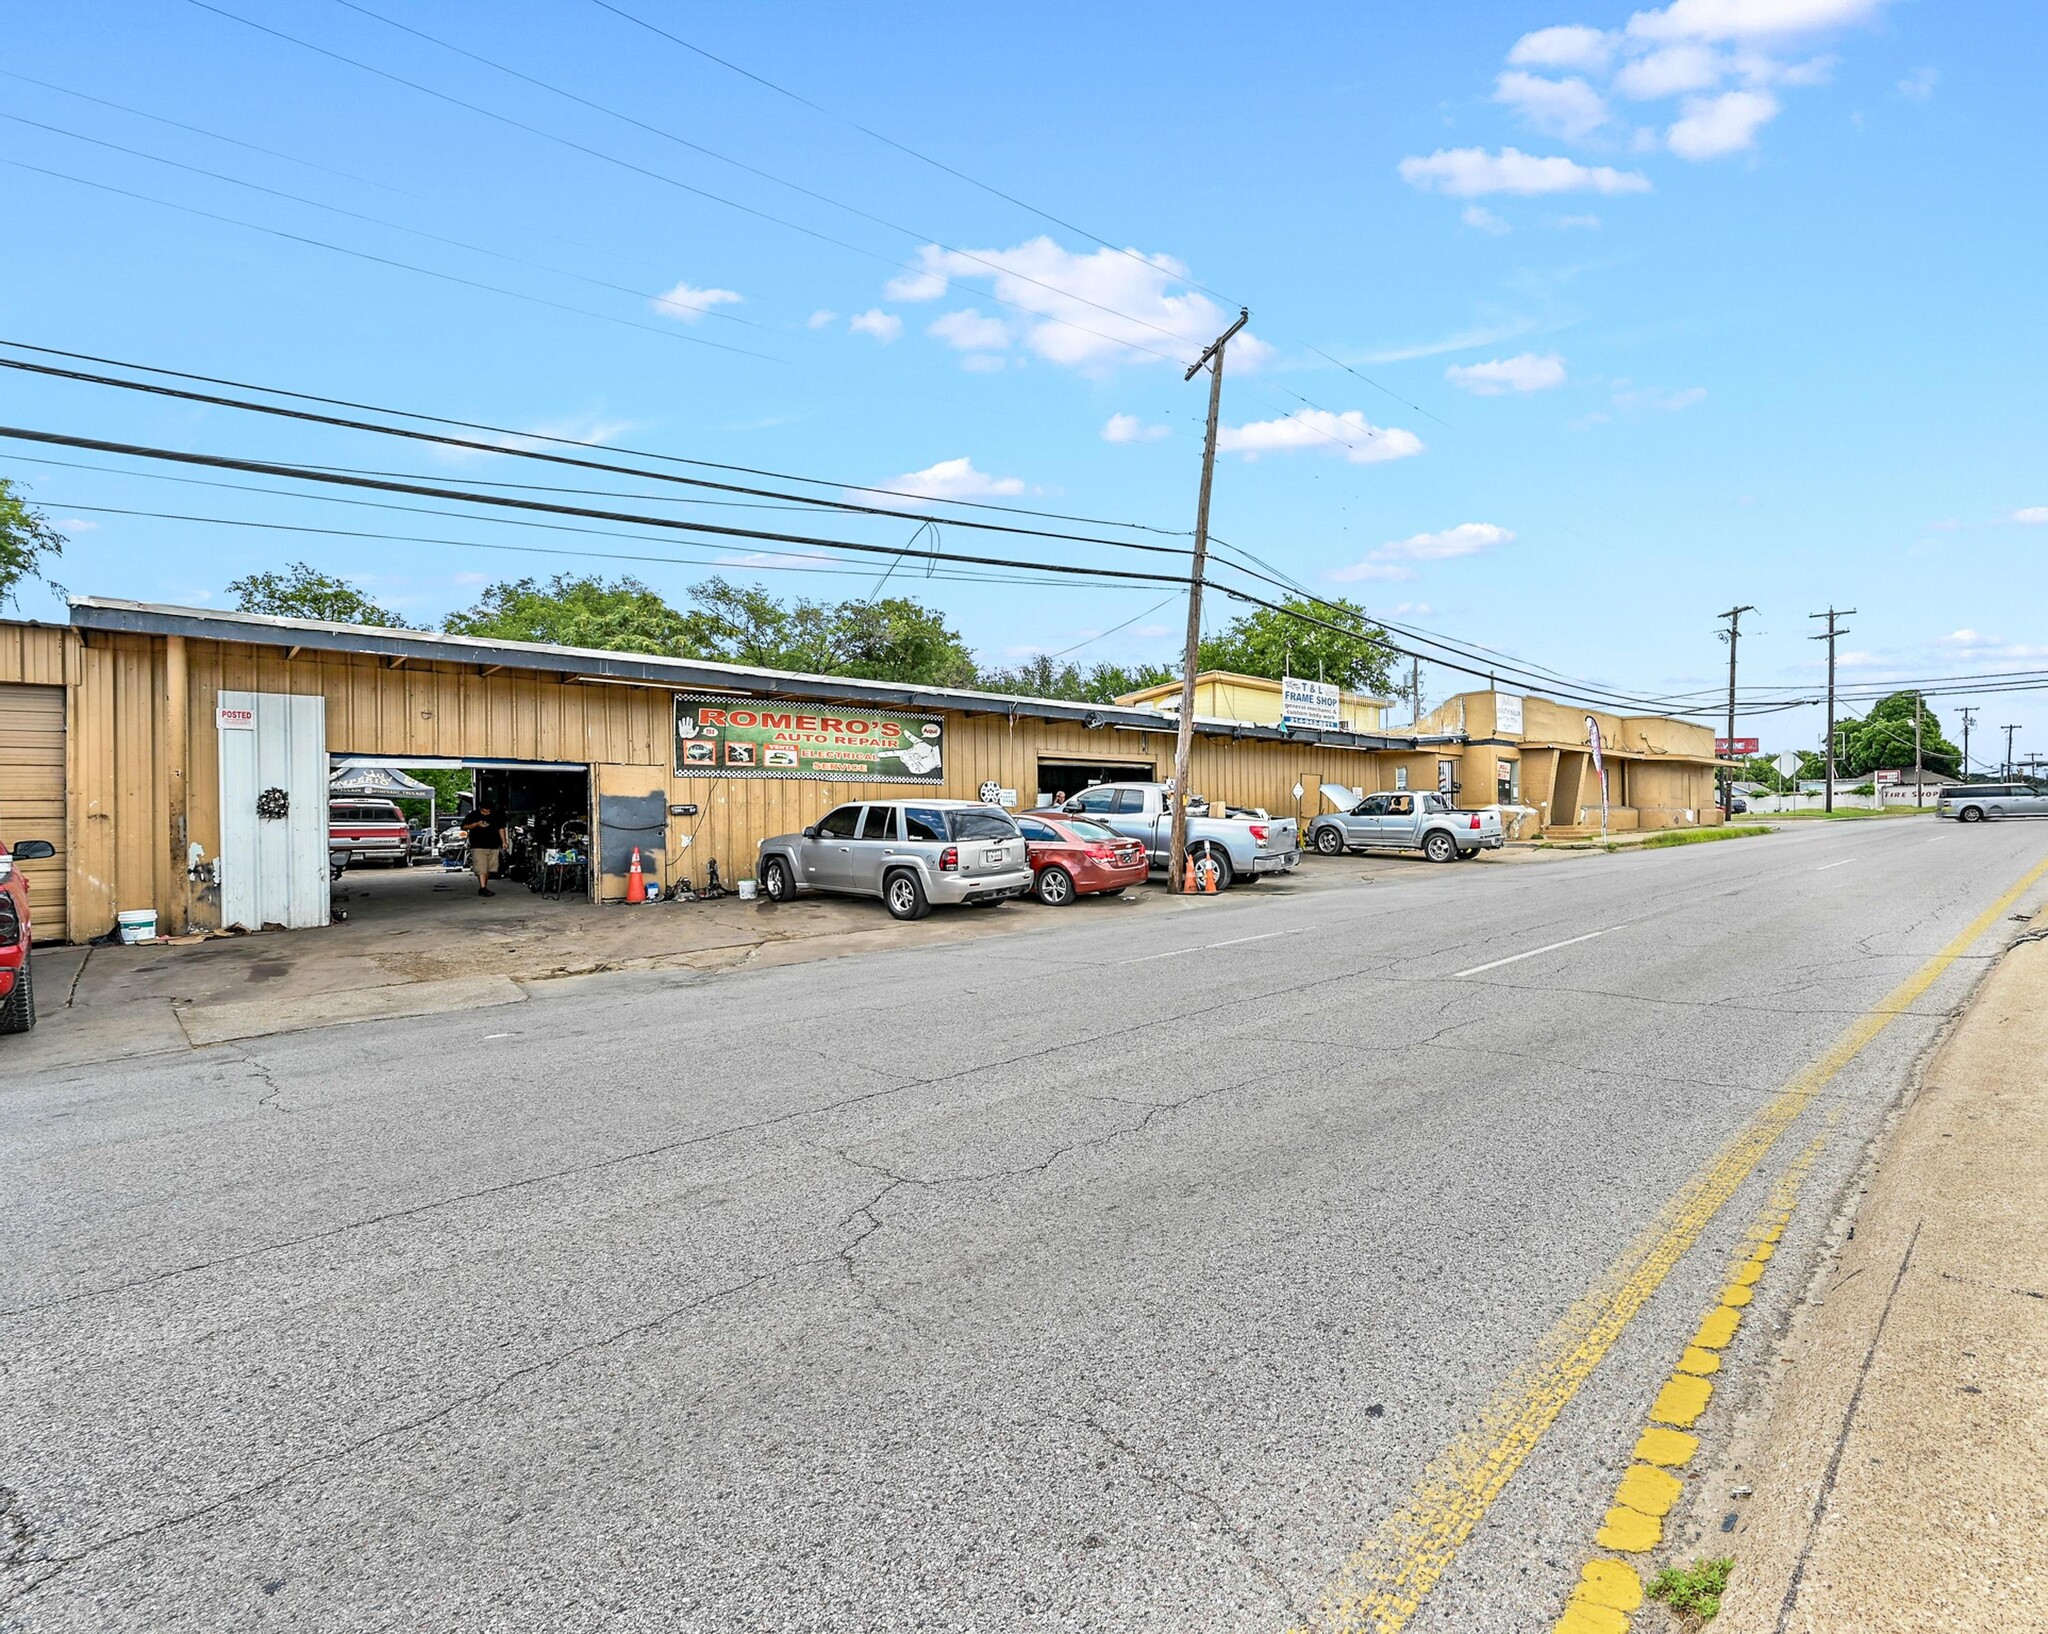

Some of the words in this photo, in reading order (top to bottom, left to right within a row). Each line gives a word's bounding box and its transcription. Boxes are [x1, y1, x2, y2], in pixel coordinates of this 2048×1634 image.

[1302, 683, 1307, 691] T
[1310, 684, 1315, 693] &
[1318, 686, 1323, 694] L
[1285, 691, 1314, 703] FRAME
[1316, 696, 1337, 706] SHOP
[221, 710, 252, 719] POSTED
[698, 708, 902, 737] ROMERO'S
[774, 732, 828, 743] AUTO
[834, 736, 899, 749] REPAIR
[801, 750, 880, 761] ELECTRICAL
[812, 762, 868, 772] SERVICE
